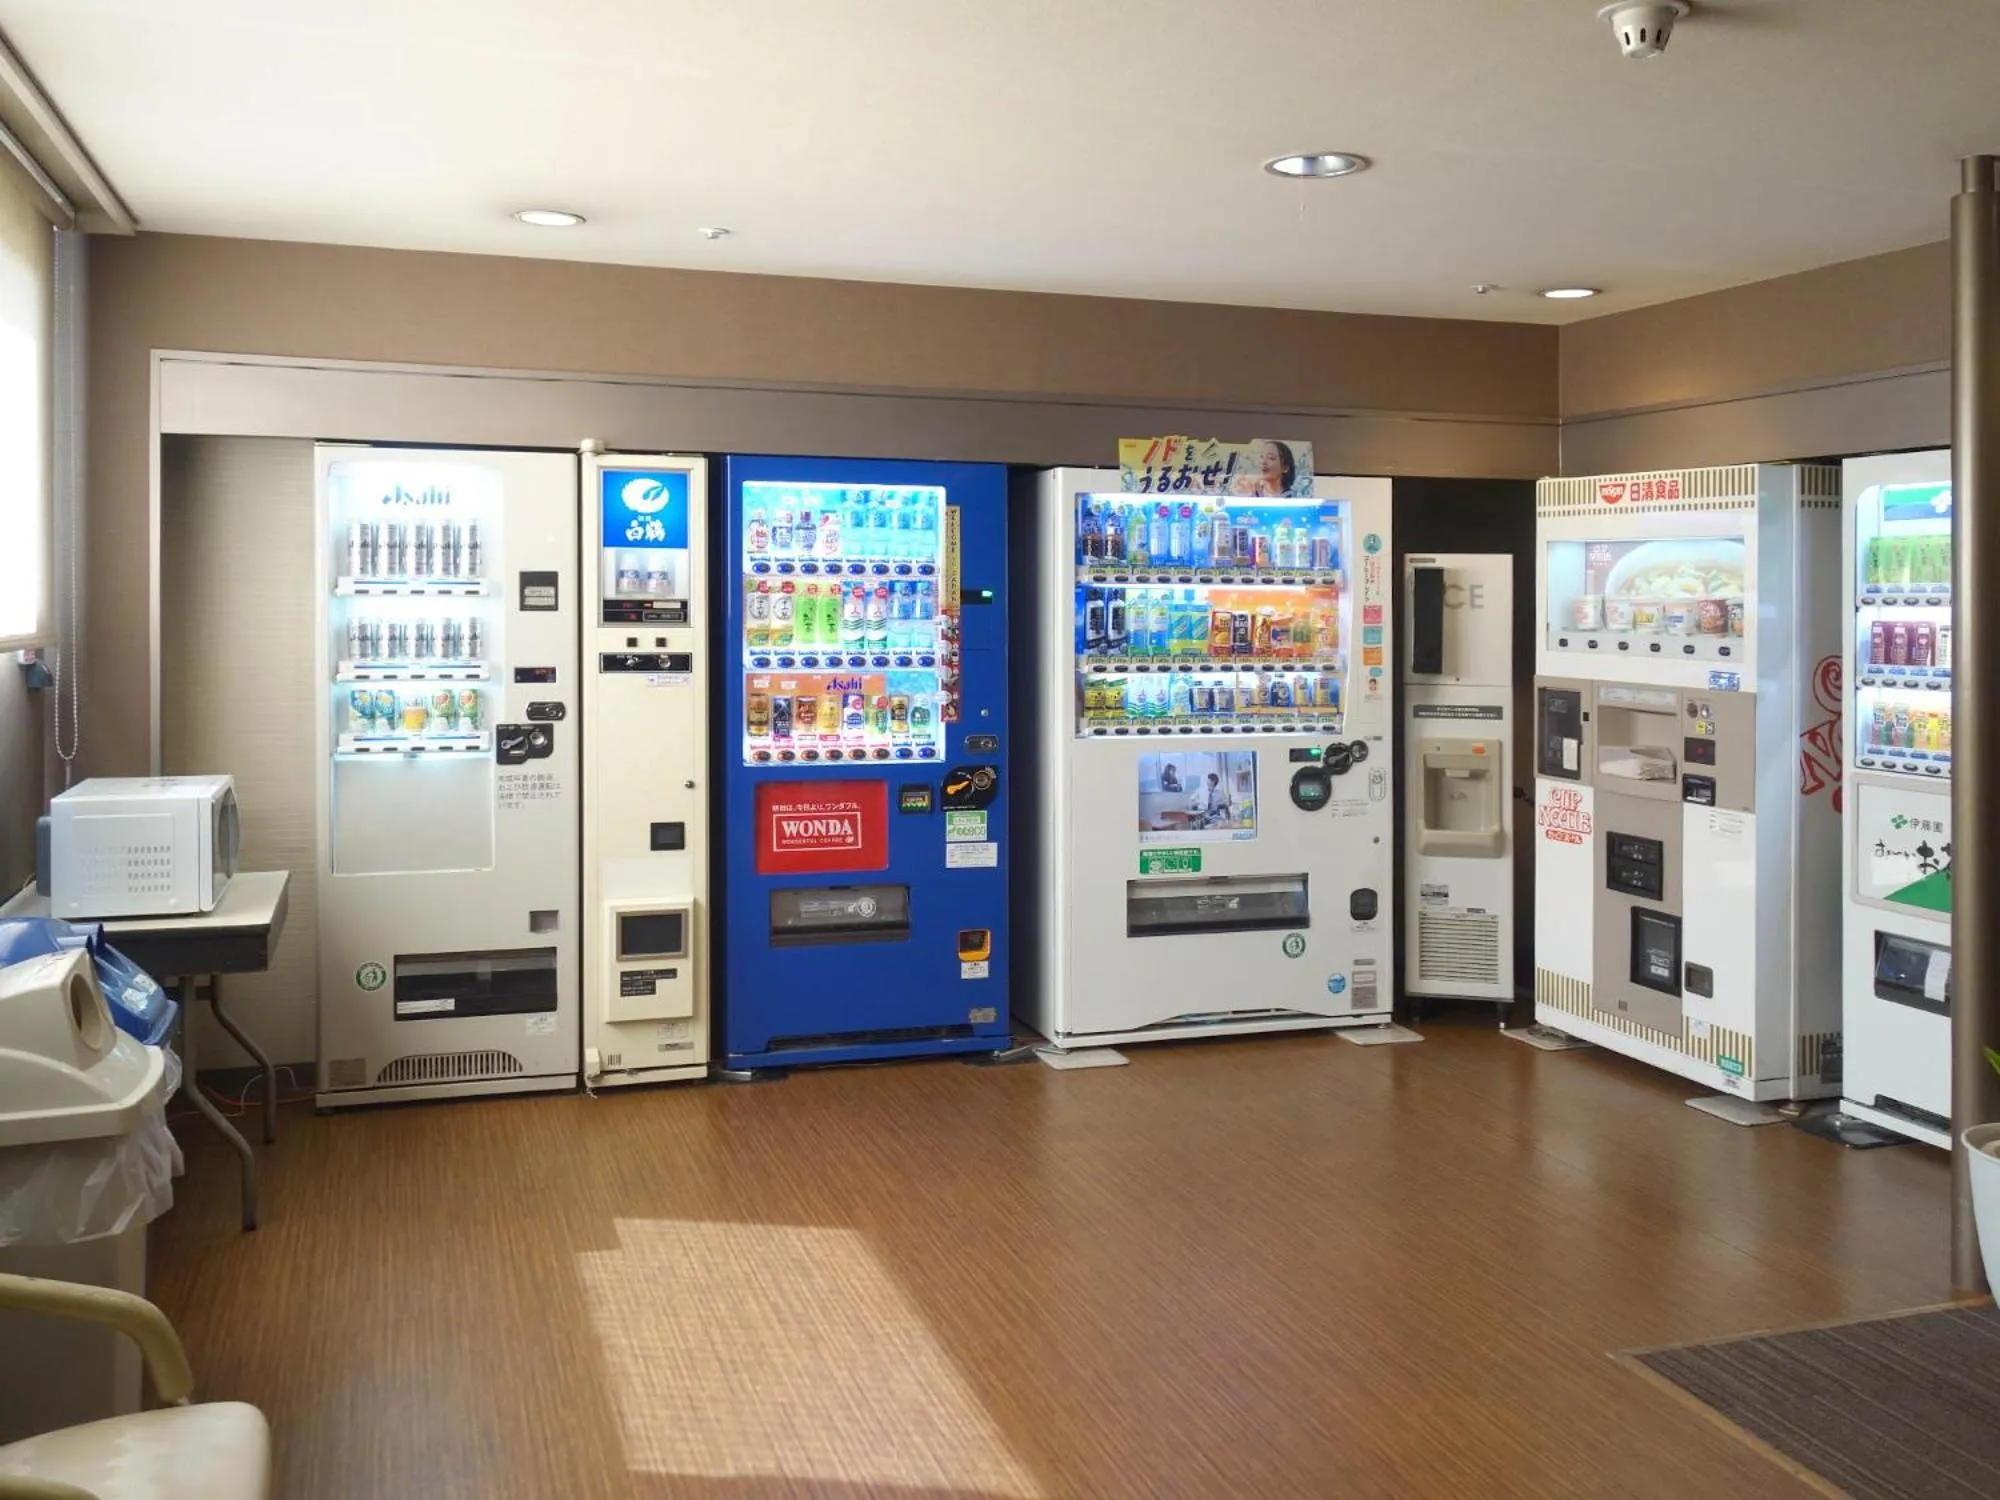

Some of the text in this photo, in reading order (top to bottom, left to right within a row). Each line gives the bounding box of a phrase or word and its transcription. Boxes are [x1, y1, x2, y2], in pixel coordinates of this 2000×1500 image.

[382, 484, 450, 505] Asahi
[1630, 480, 1679, 502] 日清食品
[625, 519, 667, 543] 白鶴
[1443, 584, 1485, 610] CE
[827, 677, 862, 691] Asahi
[781, 818, 854, 838] WONDA
[1908, 817, 1943, 834] 伊藤園
